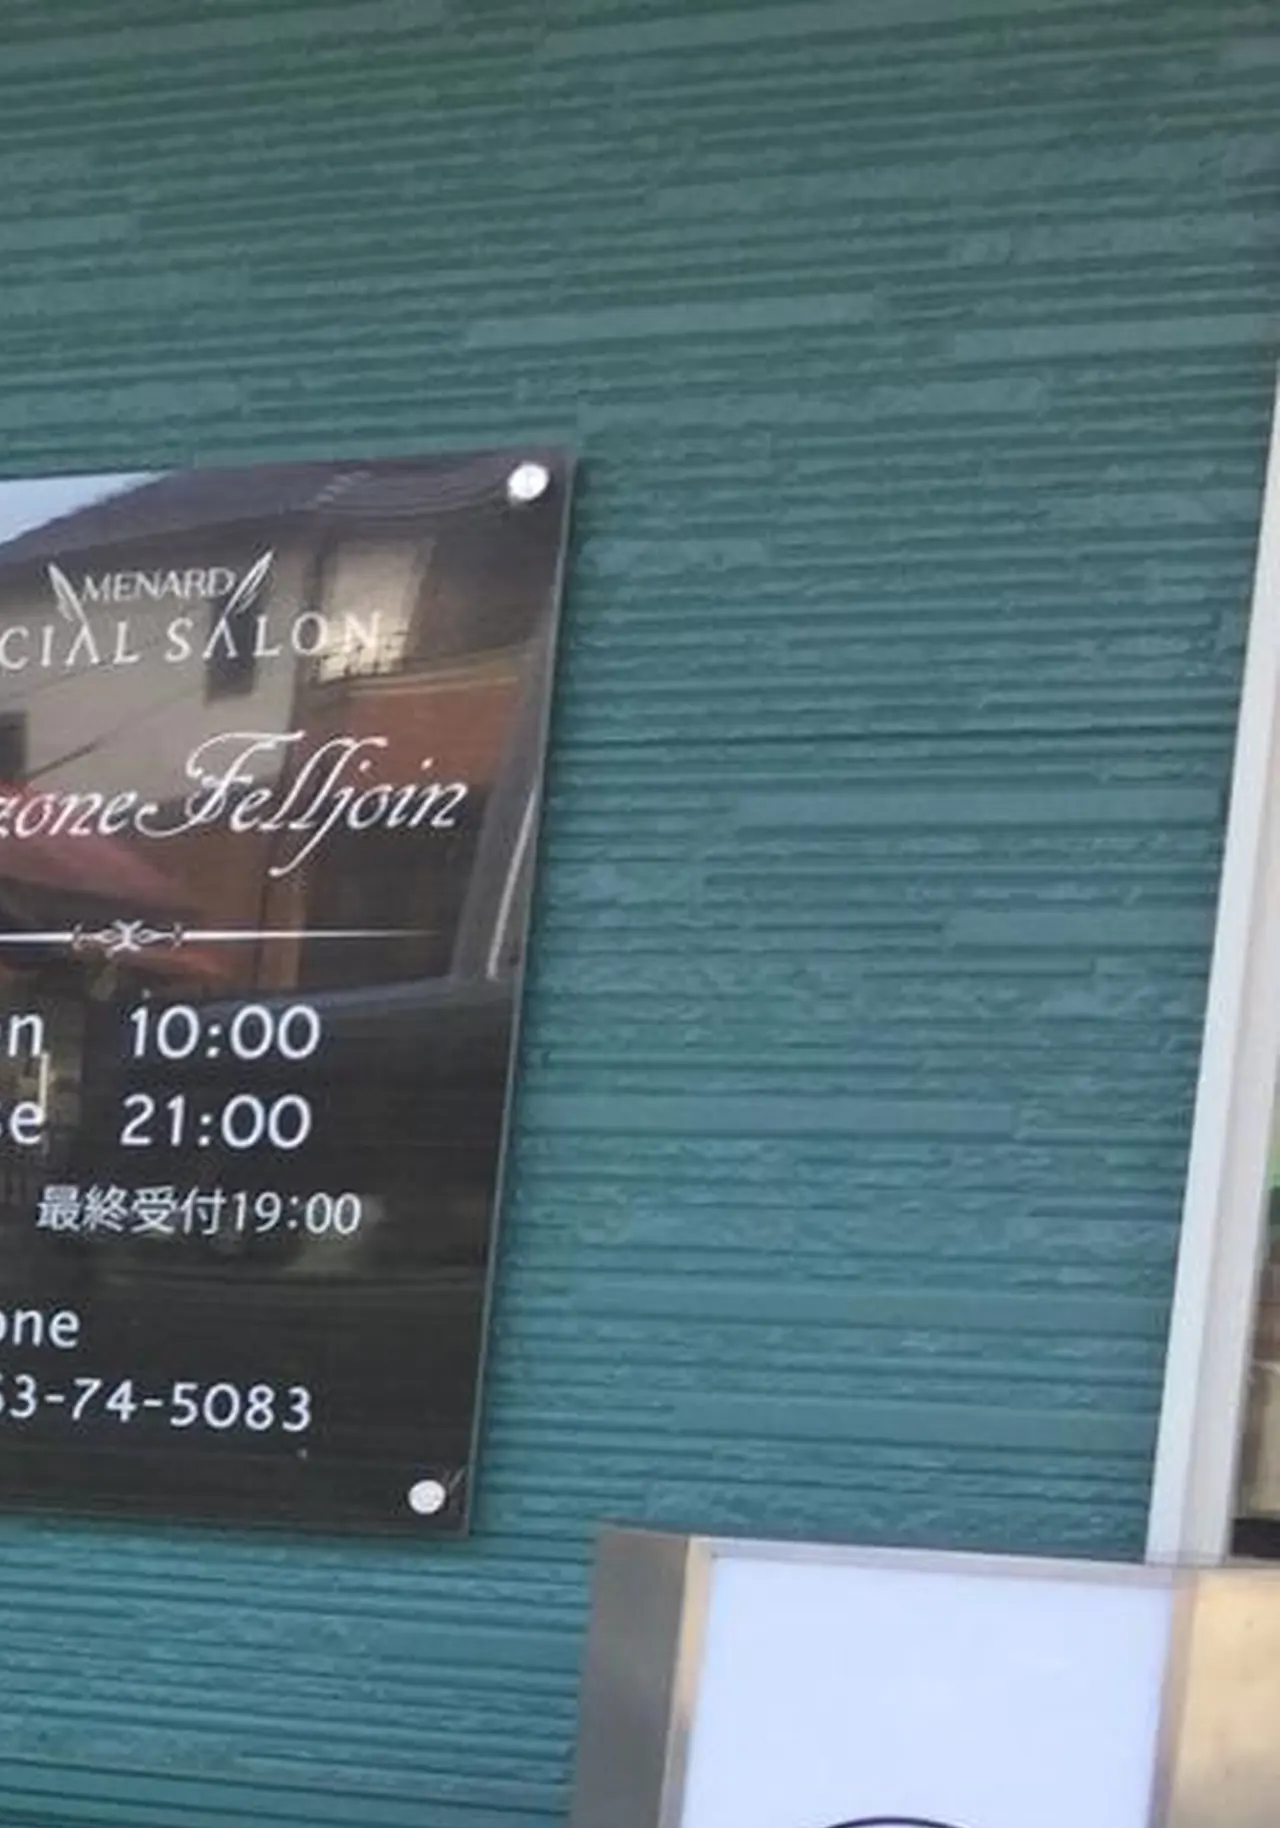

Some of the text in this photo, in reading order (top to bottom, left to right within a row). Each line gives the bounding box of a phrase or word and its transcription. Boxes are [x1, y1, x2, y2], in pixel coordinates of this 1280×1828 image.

[83, 566, 233, 602] MENARD
[165, 609, 384, 665] SALON
[136, 731, 469, 877] Felljoin
[129, 1005, 321, 1060] 10:00
[120, 1094, 313, 1149] 21:00
[37, 1187, 363, 1236] 最終受付19:00
